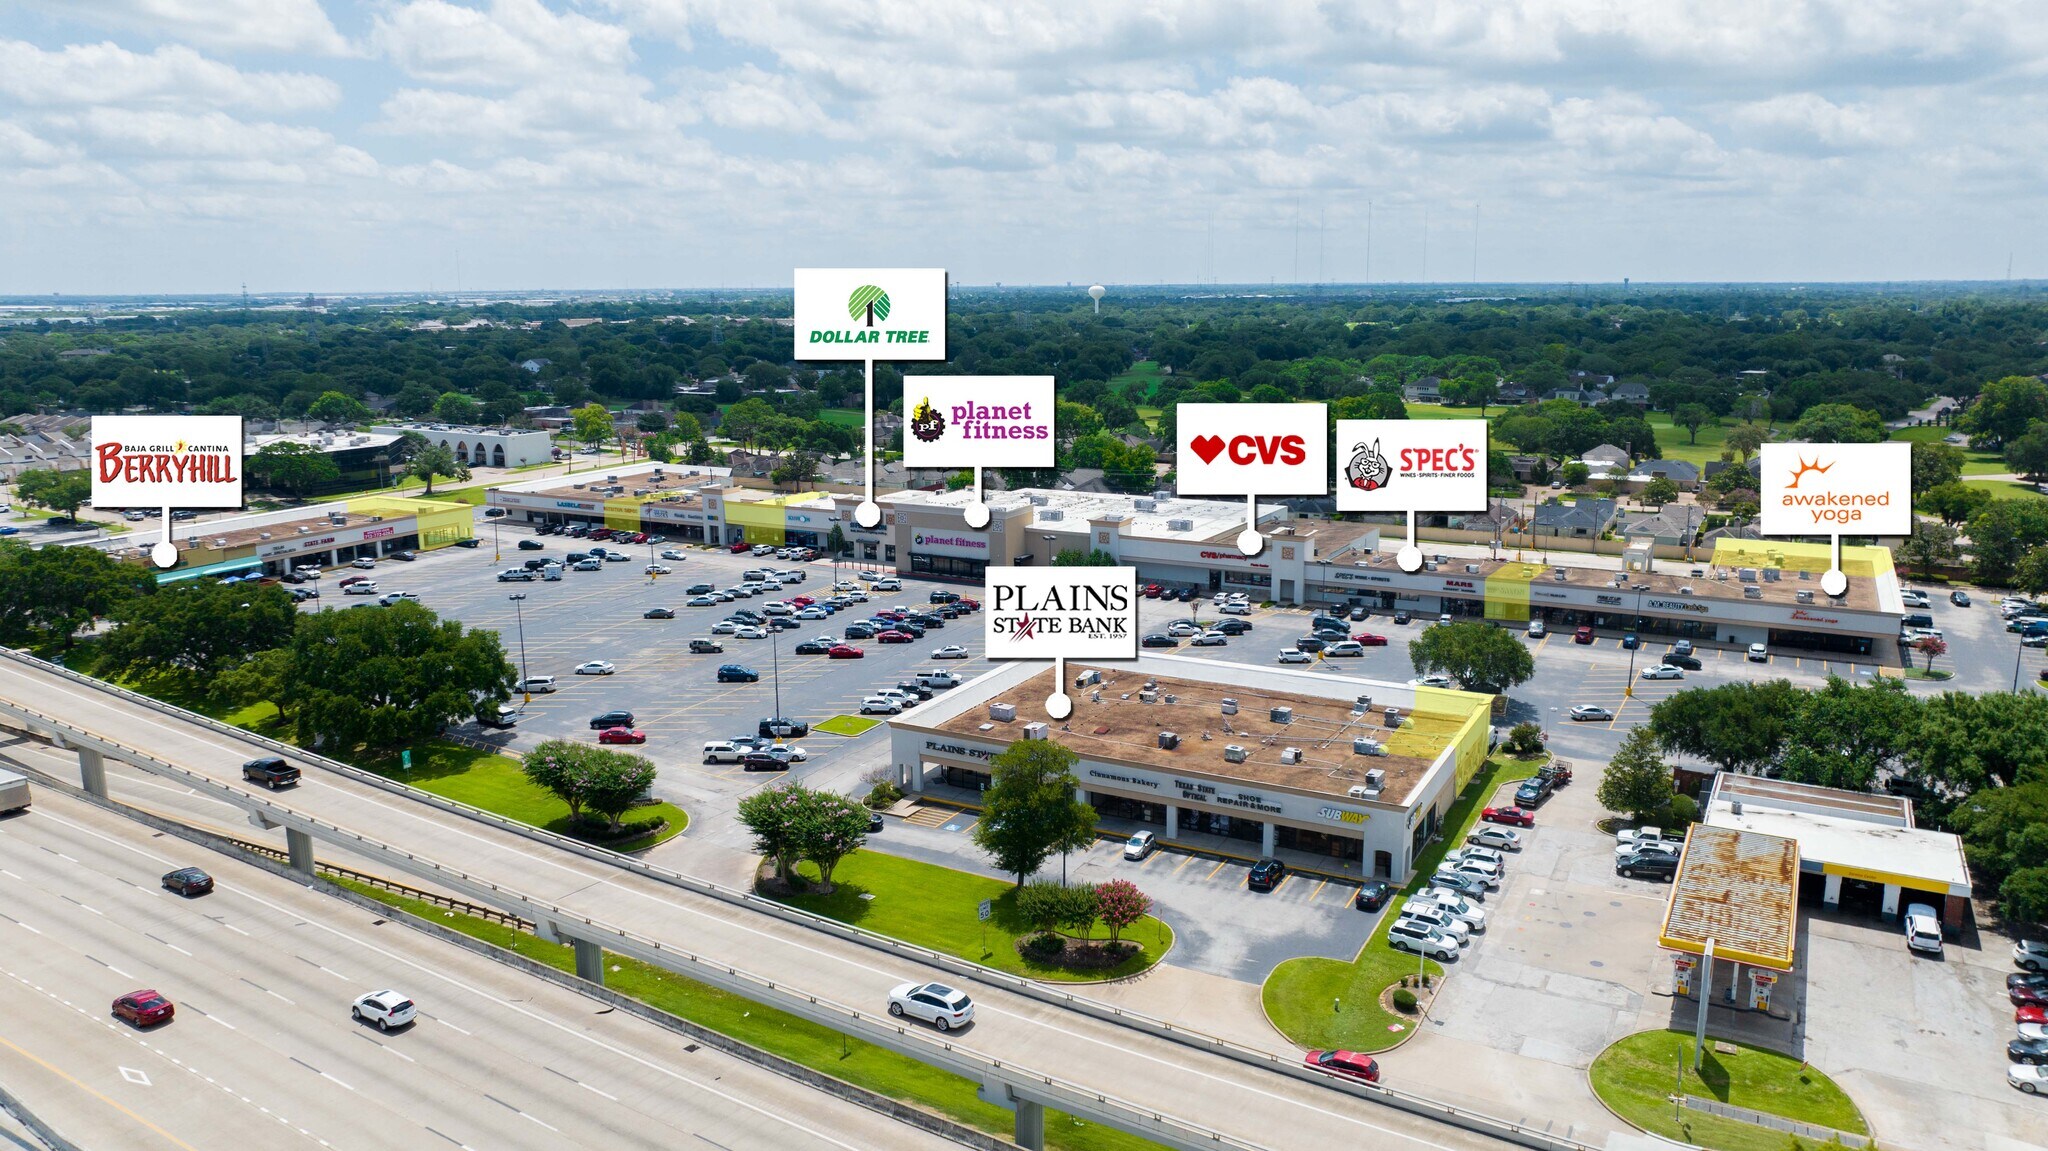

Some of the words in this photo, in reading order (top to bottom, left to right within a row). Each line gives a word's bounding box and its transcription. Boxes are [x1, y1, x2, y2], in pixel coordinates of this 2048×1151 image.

[320, 537, 335, 545] FARM
[925, 535, 954, 545] planet
[955, 538, 986, 549] fitness
[1446, 580, 1473, 588] MARS
[926, 741, 966, 755] PLAINS
[1089, 769, 1130, 783] Cinnamons
[1132, 777, 1159, 789] Bakery
[1174, 779, 1195, 791] TEXAS
[1197, 784, 1216, 795] STATE
[1182, 790, 1207, 802] OPTICAL
[1237, 793, 1262, 804] SHOE
[1216, 796, 1250, 808] REPAIR
[1256, 804, 1282, 814] MORE
[1318, 807, 1370, 825] SUBWAY
[980, 910, 989, 919] 50
